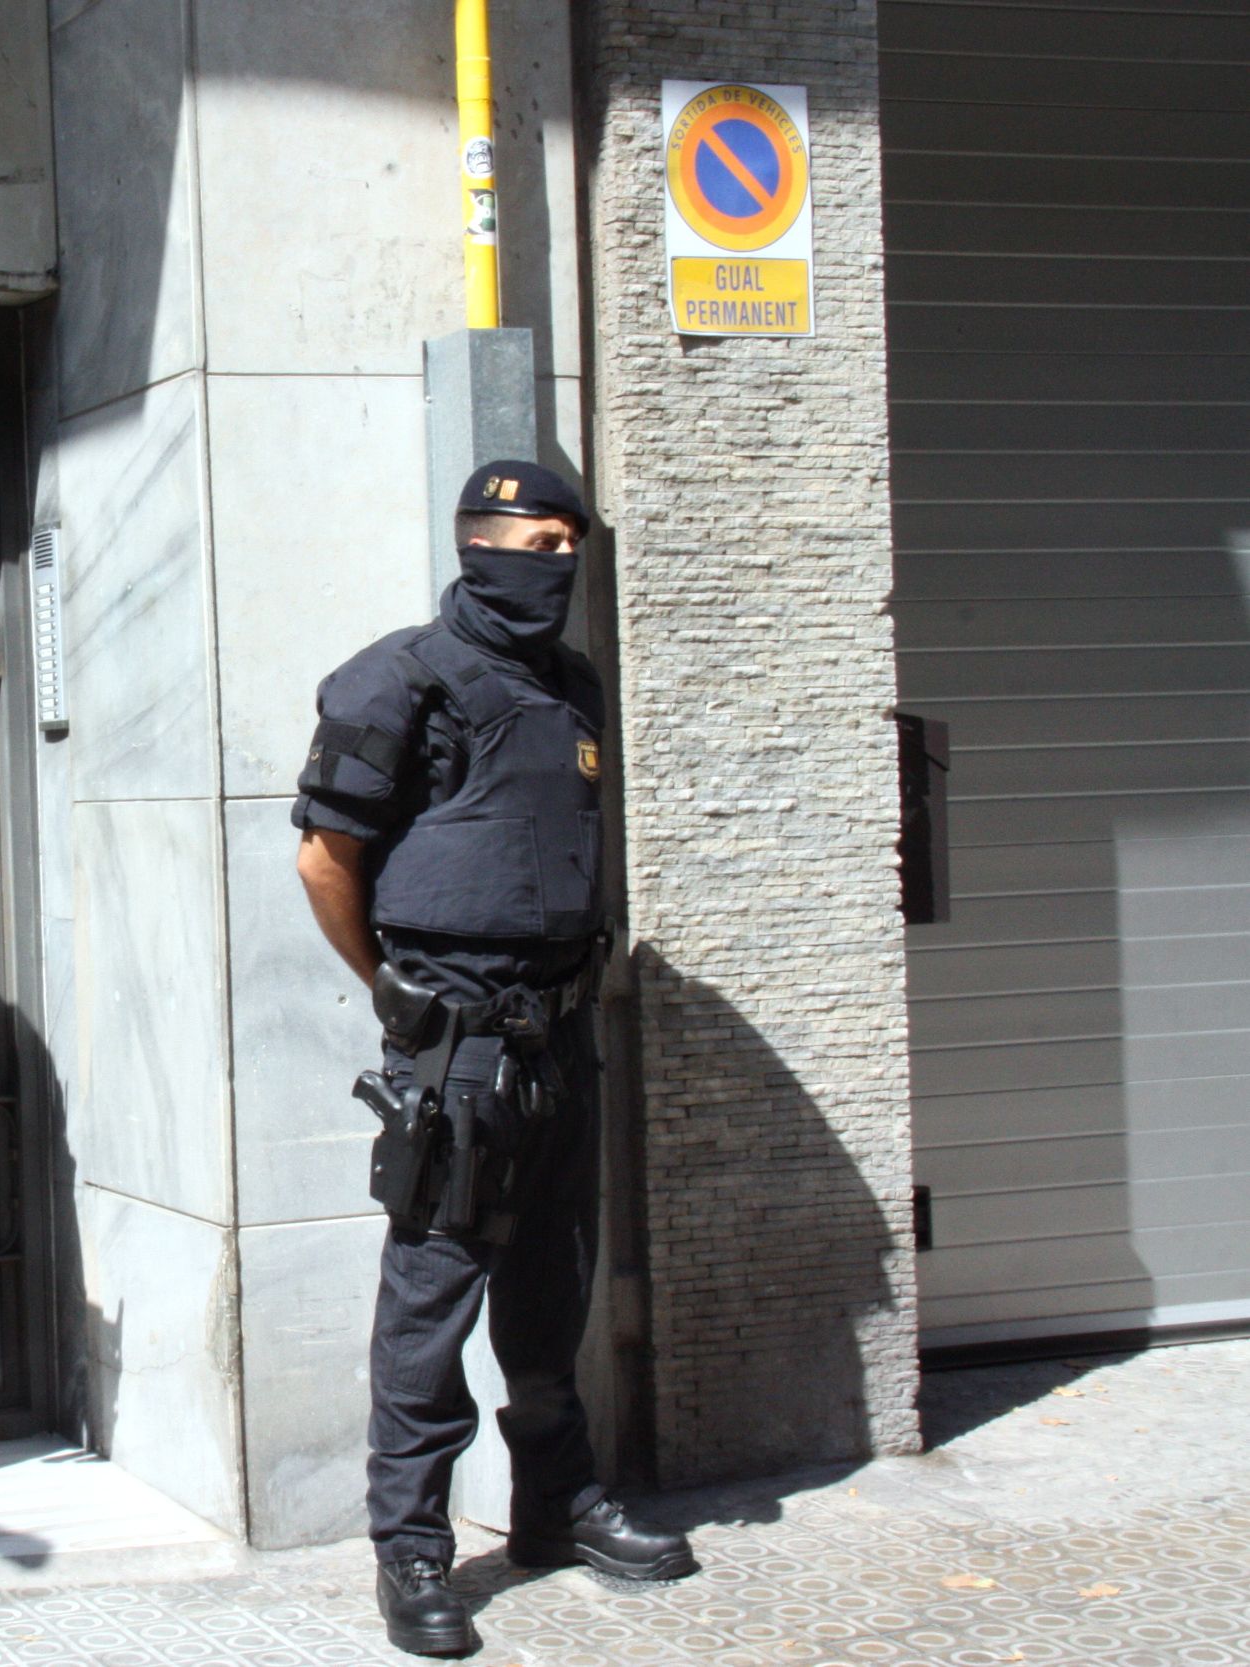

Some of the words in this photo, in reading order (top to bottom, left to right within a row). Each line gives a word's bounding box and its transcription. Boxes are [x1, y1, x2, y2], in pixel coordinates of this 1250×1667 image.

[671, 94, 717, 150] SORTIDA
[723, 89, 741, 102] DE
[749, 93, 802, 154] VEHICLES
[716, 264, 764, 291] GUAL
[686, 300, 797, 326] PERMANENT
